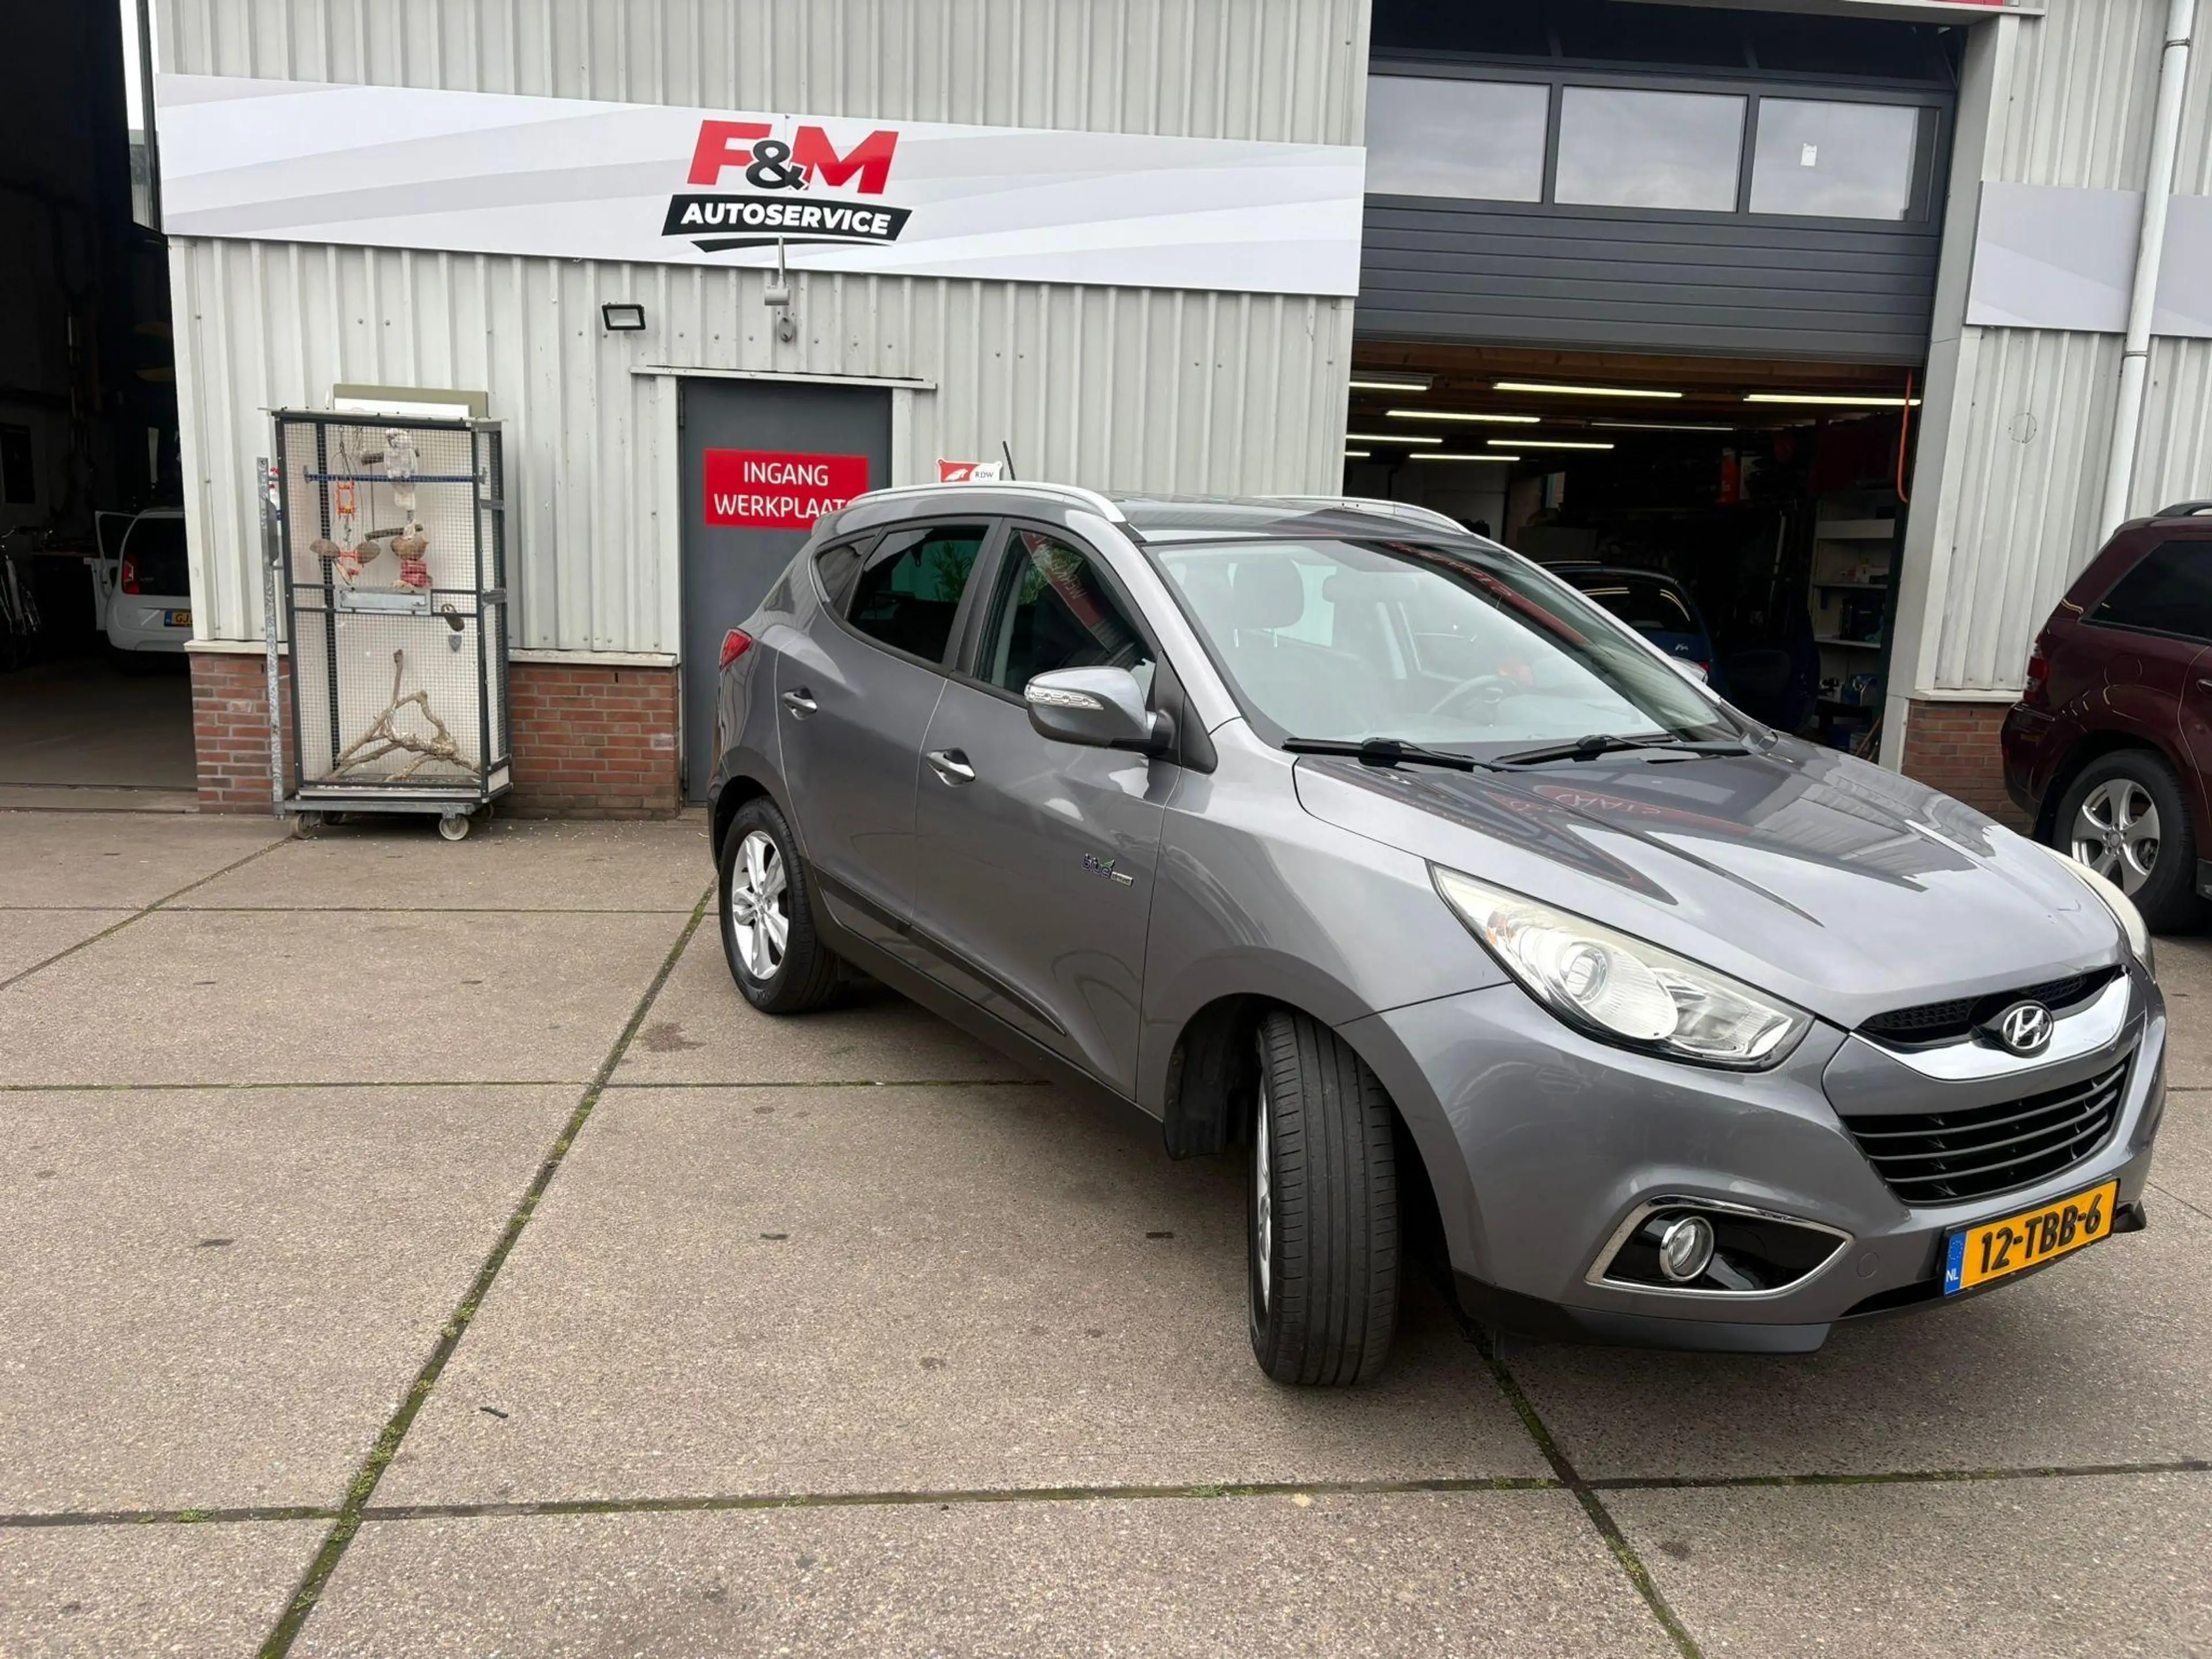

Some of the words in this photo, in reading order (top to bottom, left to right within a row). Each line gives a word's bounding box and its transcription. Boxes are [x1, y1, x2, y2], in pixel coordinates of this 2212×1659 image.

[687, 120, 898, 195] F&M
[681, 203, 891, 235] AUTOSERVICE
[744, 461, 829, 487] INGANG
[975, 471, 994, 479] RDW
[714, 493, 849, 518] WERKPLAAT
[175, 613, 192, 623] GJ
[1981, 1194, 2101, 1274] 12-TBB-6
[1946, 1269, 1959, 1283] NL
